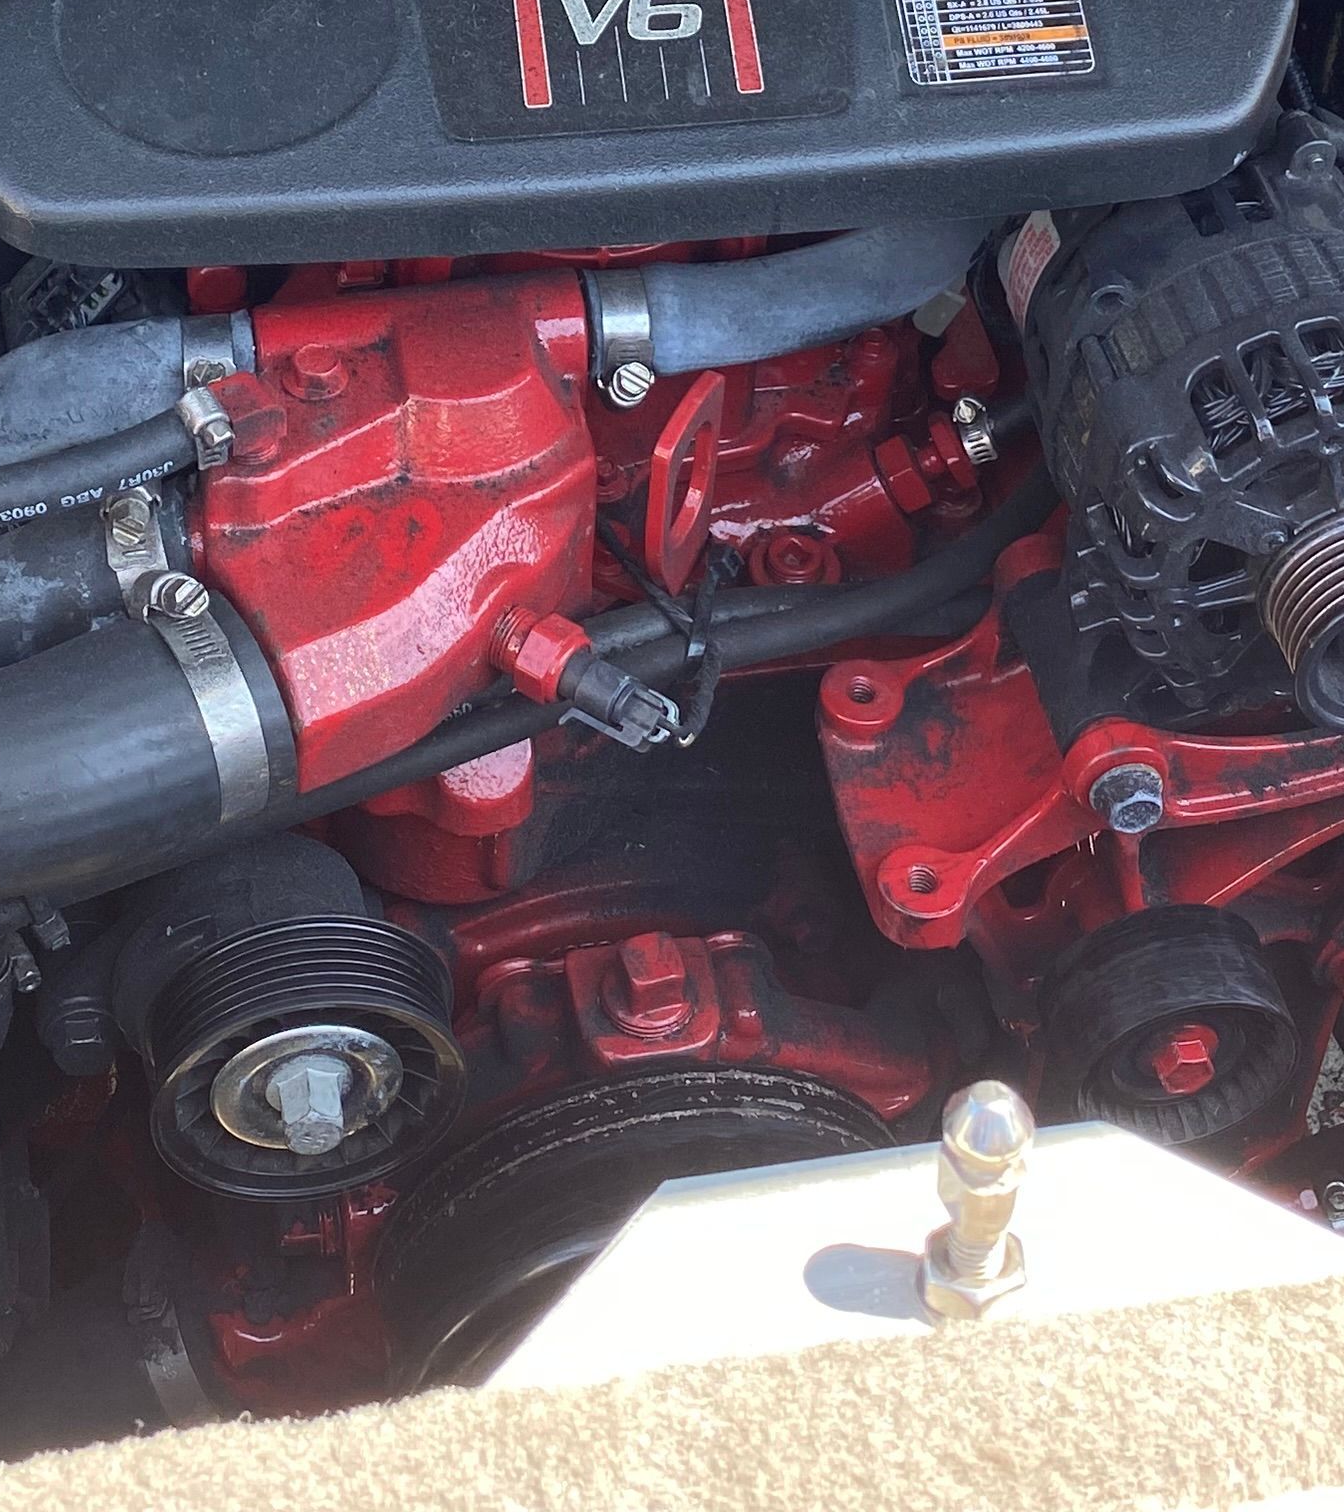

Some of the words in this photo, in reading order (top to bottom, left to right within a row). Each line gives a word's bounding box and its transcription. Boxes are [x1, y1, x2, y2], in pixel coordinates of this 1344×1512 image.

[995, 10, 1008, 18] US
[956, 48, 974, 57] Max
[976, 48, 994, 56] WOT
[996, 46, 1014, 55] RPM
[959, 60, 976, 69] Max
[978, 59, 997, 68] WOT
[998, 58, 1017, 66] RPM
[117, 460, 174, 491] J30R7
[61, 486, 104, 508] ABG
